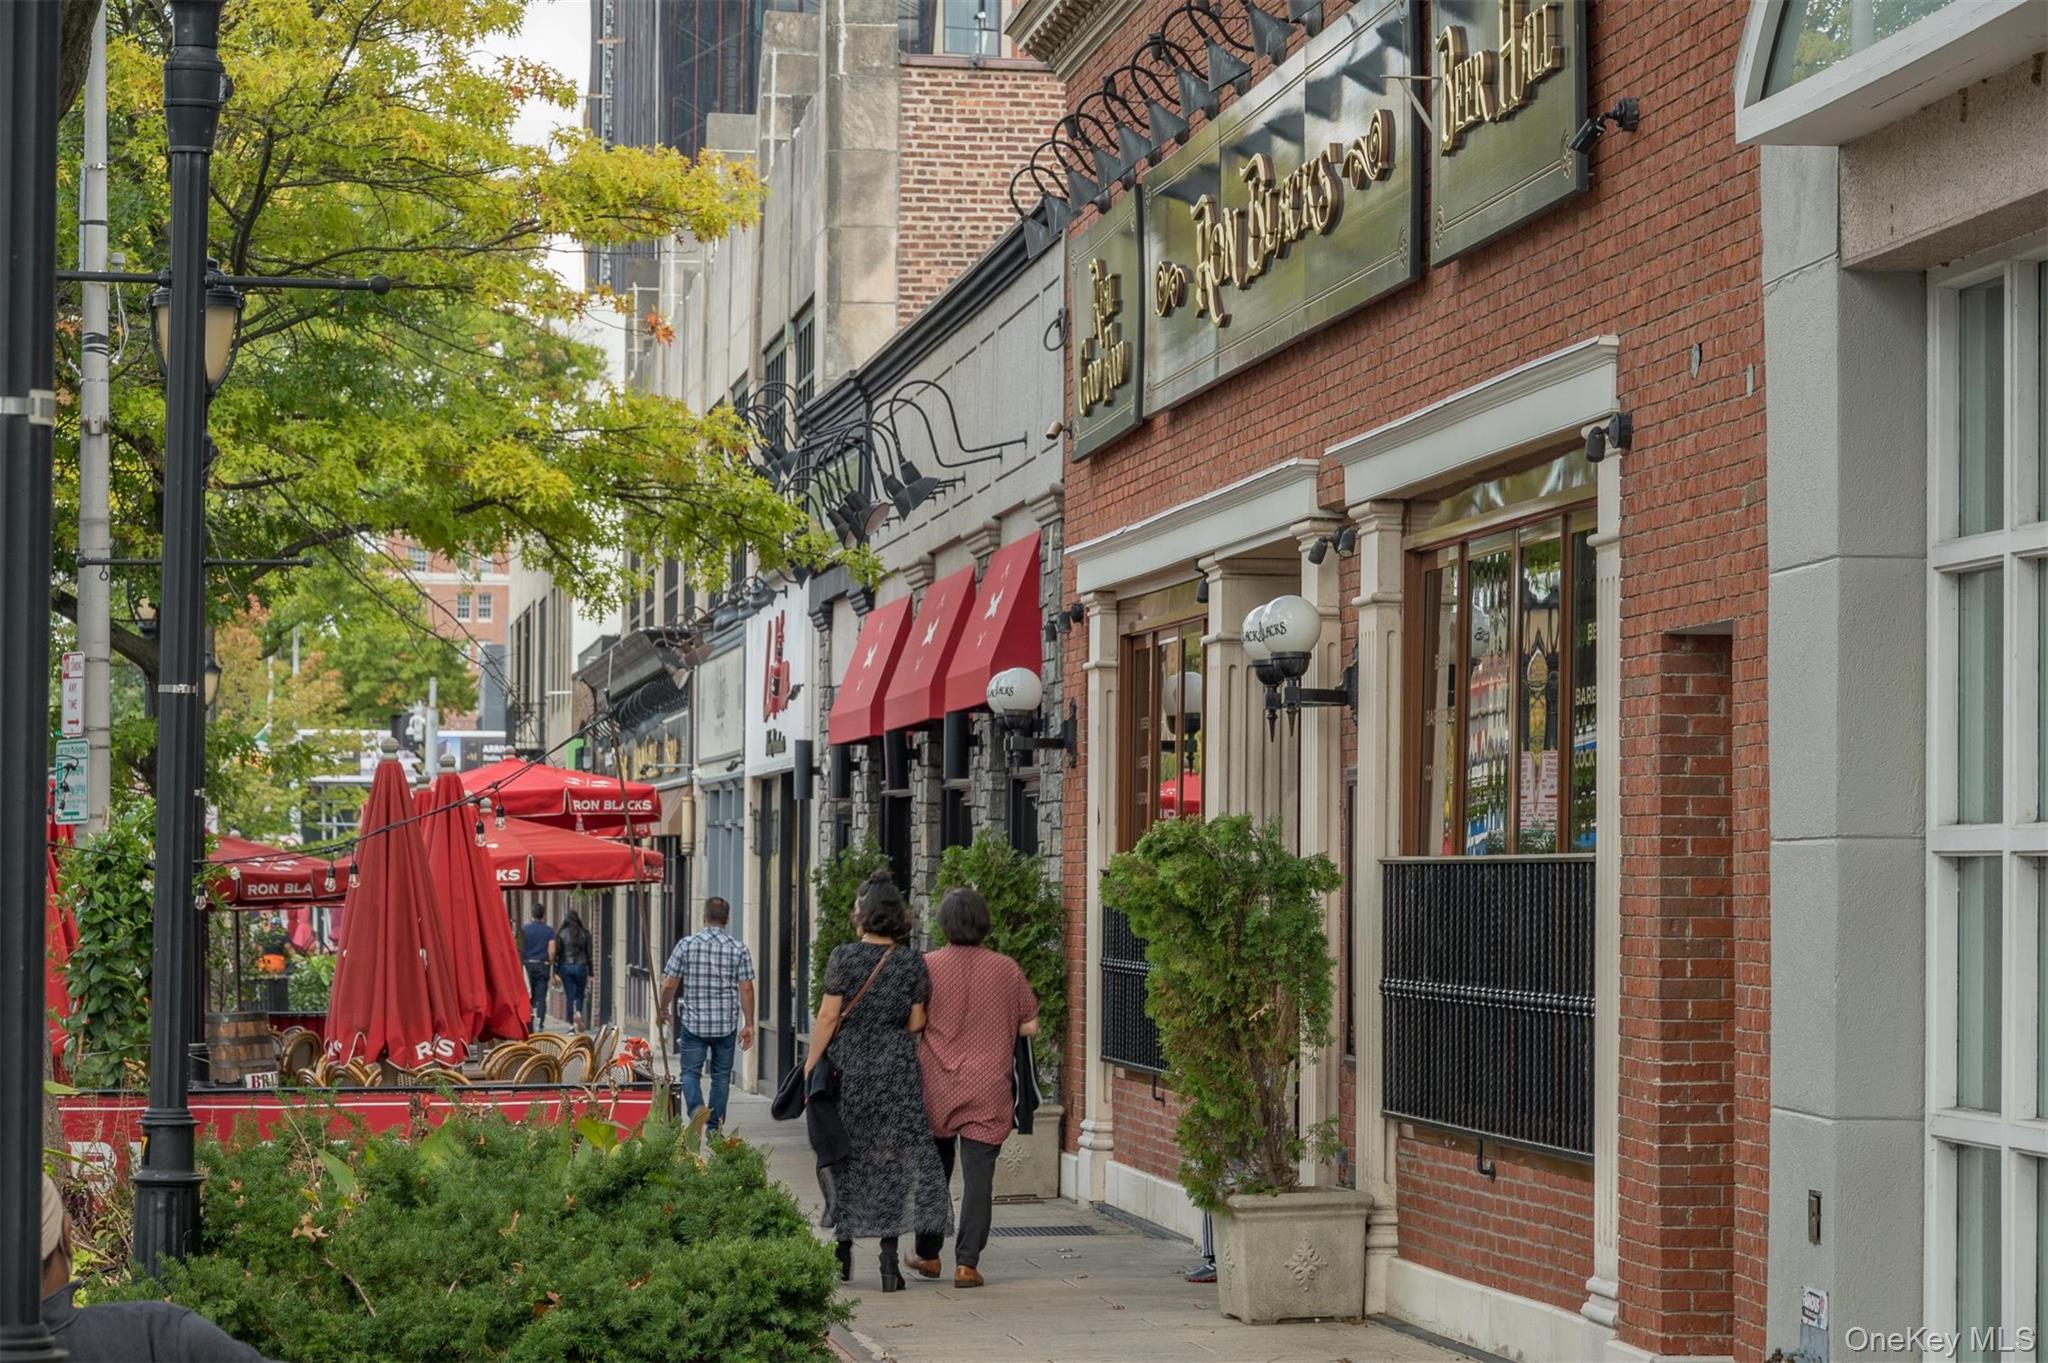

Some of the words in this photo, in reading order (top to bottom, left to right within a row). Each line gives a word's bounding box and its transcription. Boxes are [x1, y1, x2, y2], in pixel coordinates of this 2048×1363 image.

[1435, 25, 1492, 150] BEER
[1497, 0, 1559, 121] HALL
[1190, 194, 1243, 327] RON
[1239, 149, 1341, 278] BLACKS
[573, 800, 600, 811] RON
[247, 884, 279, 895] RON
[284, 883, 313, 894] BLA
